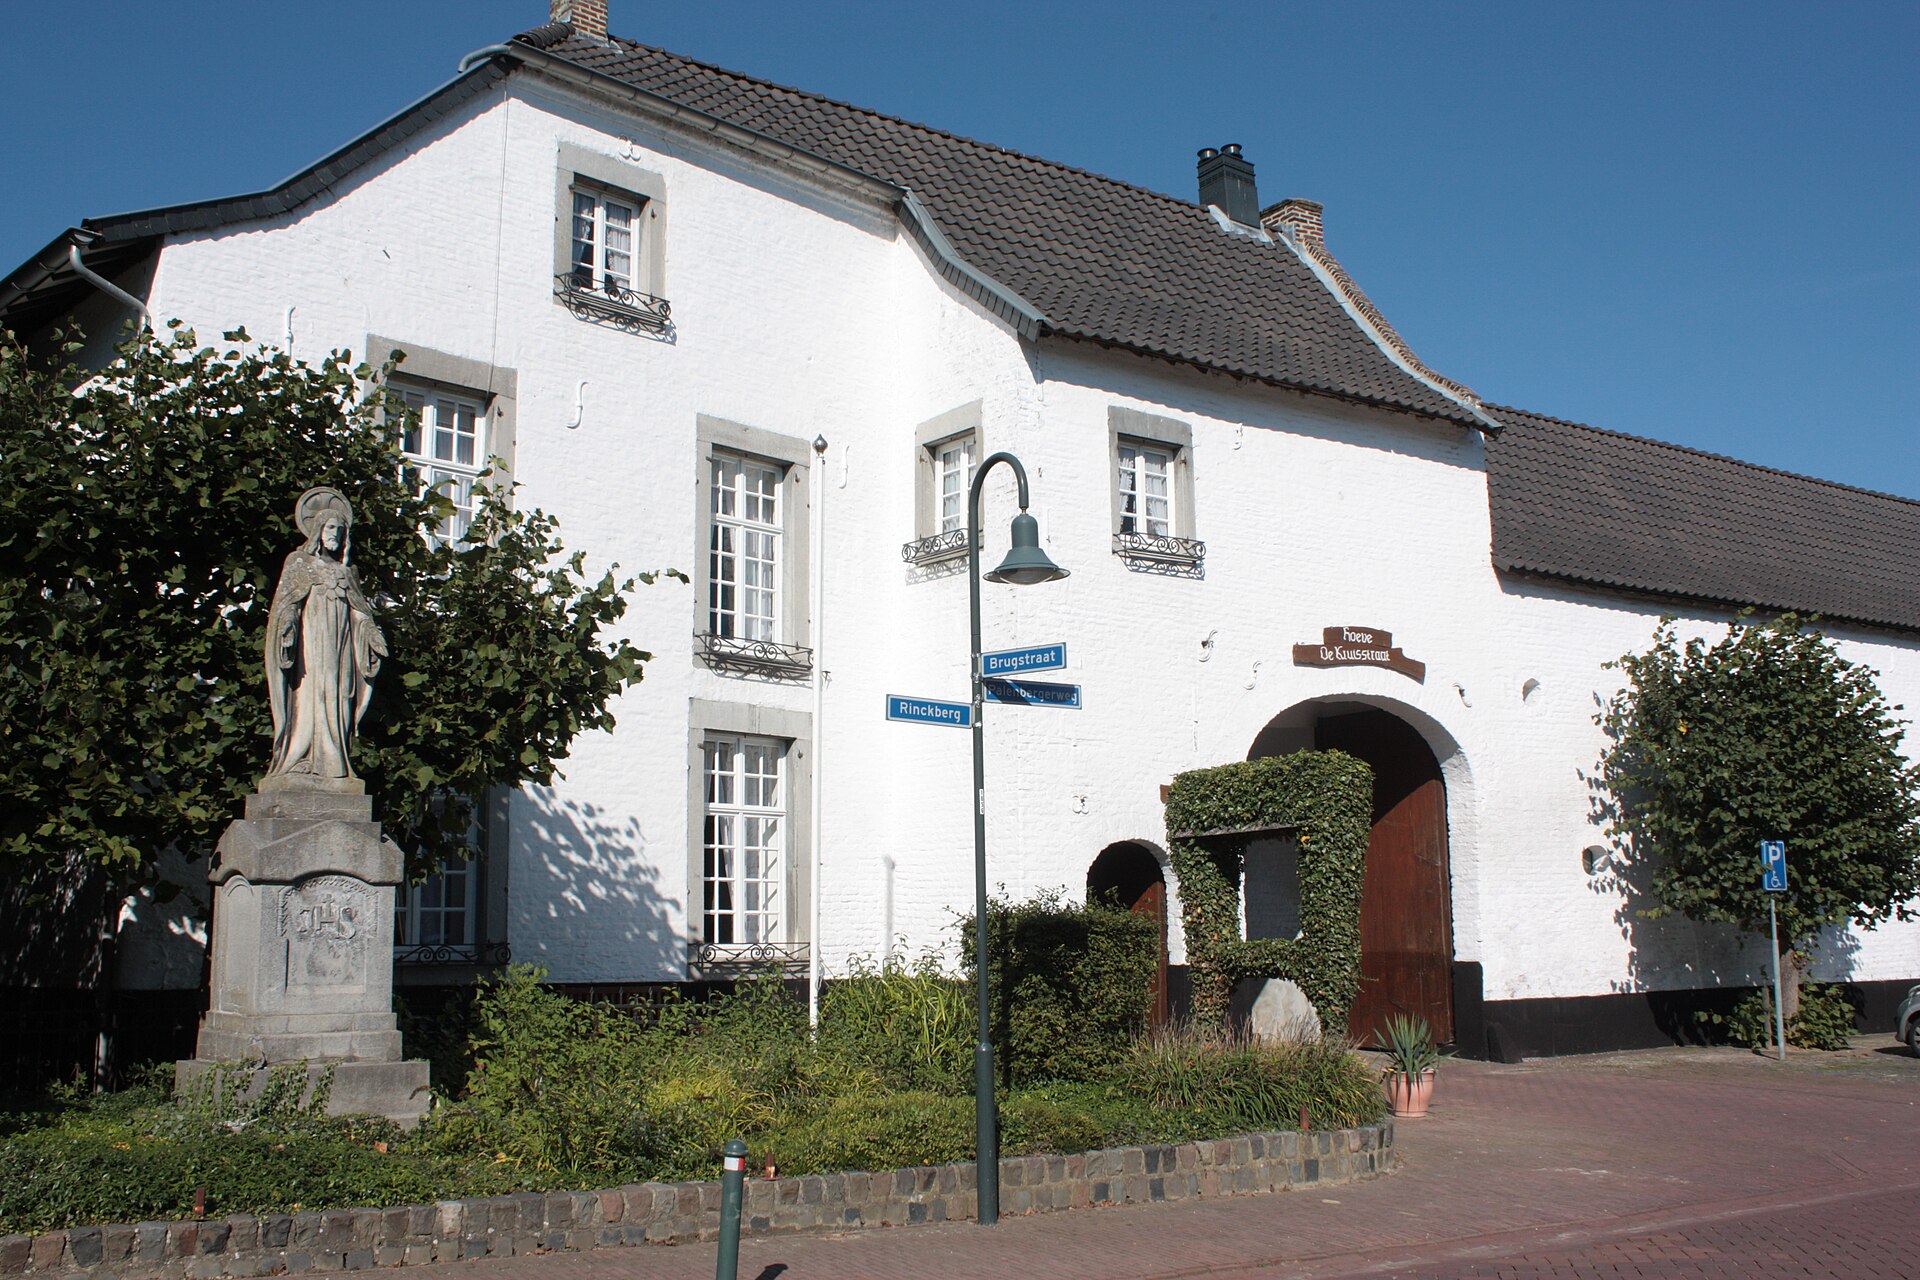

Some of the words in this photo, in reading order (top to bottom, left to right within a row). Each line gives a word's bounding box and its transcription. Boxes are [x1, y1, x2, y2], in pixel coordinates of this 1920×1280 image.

[989, 650, 1056, 670] Brugstraat
[1320, 646, 1335, 661] De
[988, 684, 1078, 704] Palenbergerweg
[900, 701, 961, 723] Rinckberg
[1769, 845, 1781, 867] P
